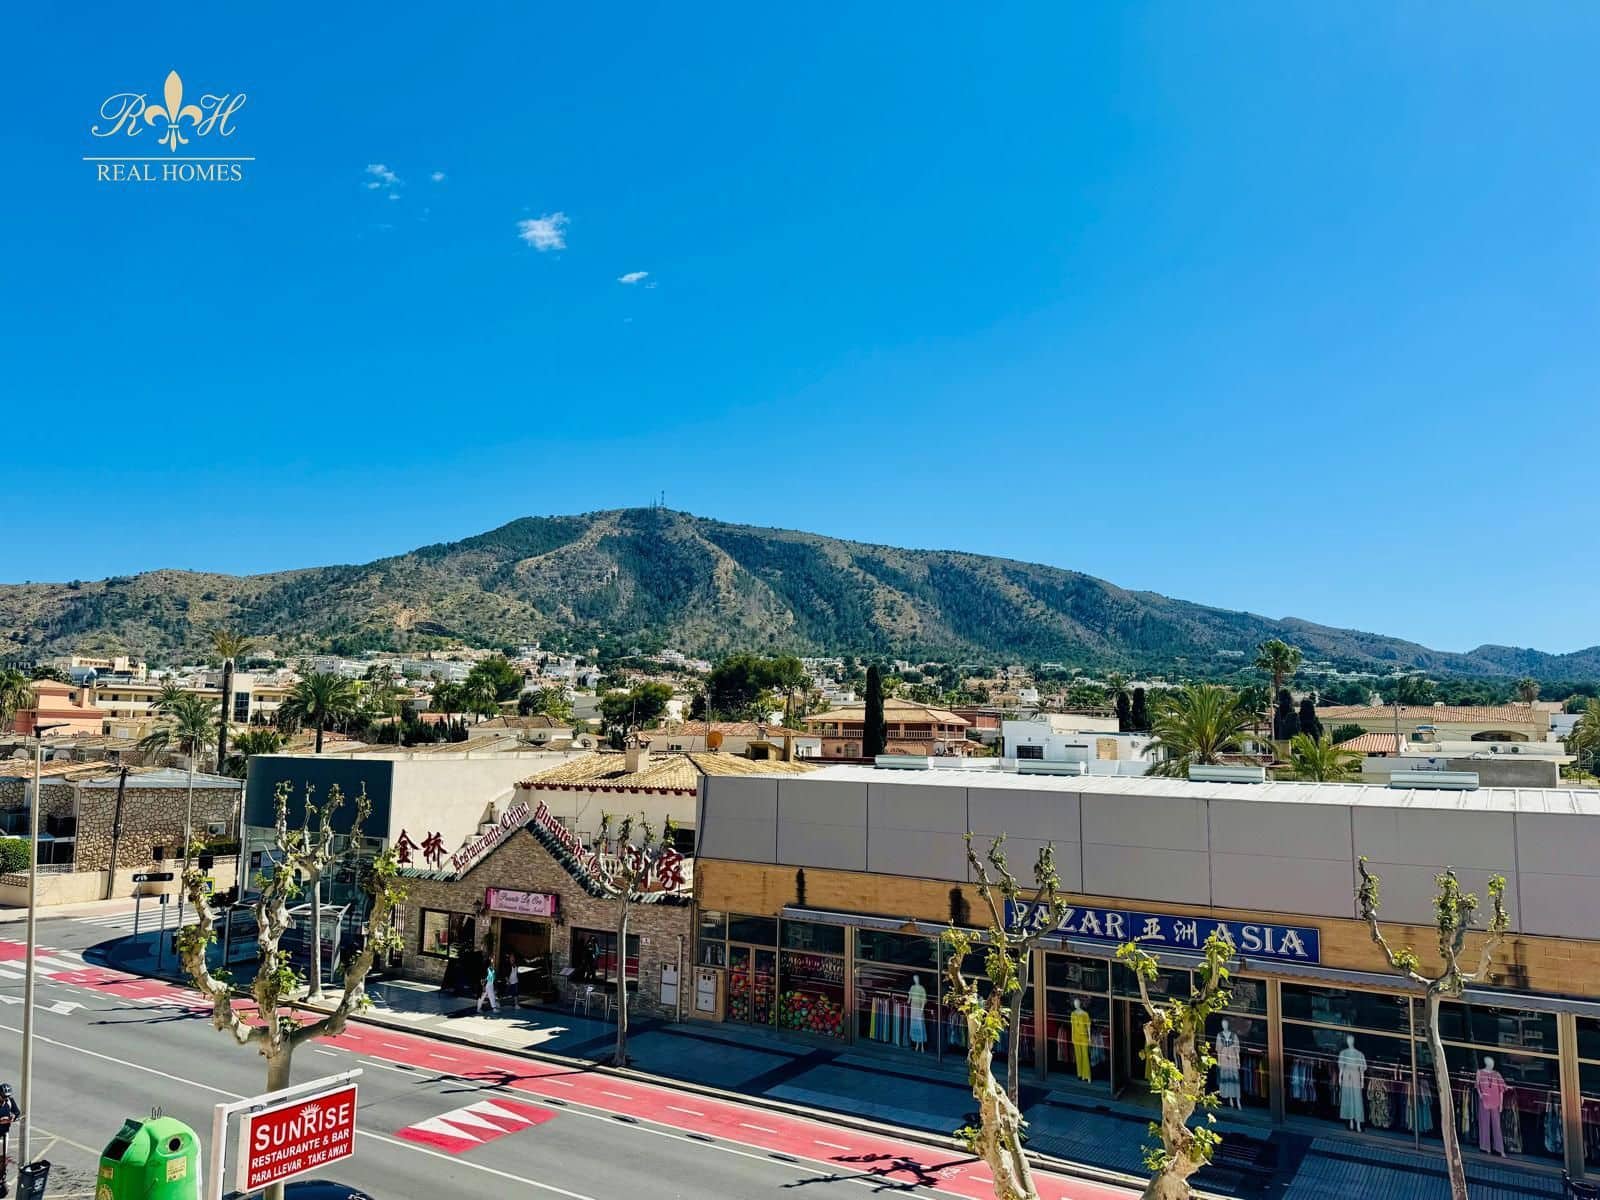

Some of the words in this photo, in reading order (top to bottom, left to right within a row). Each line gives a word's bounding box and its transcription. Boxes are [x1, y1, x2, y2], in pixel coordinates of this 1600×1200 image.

[1201, 922, 1309, 957] ASIA
[254, 1103, 350, 1151] SUNRISE
[251, 1138, 321, 1169] RESTAURANTE
[322, 1135, 329, 1145] &
[331, 1129, 350, 1143] BAR
[251, 1172, 272, 1185] PARA
[273, 1159, 302, 1177] LLEVAR
[308, 1150, 327, 1166] TAKE
[328, 1143, 348, 1160] AWAY
